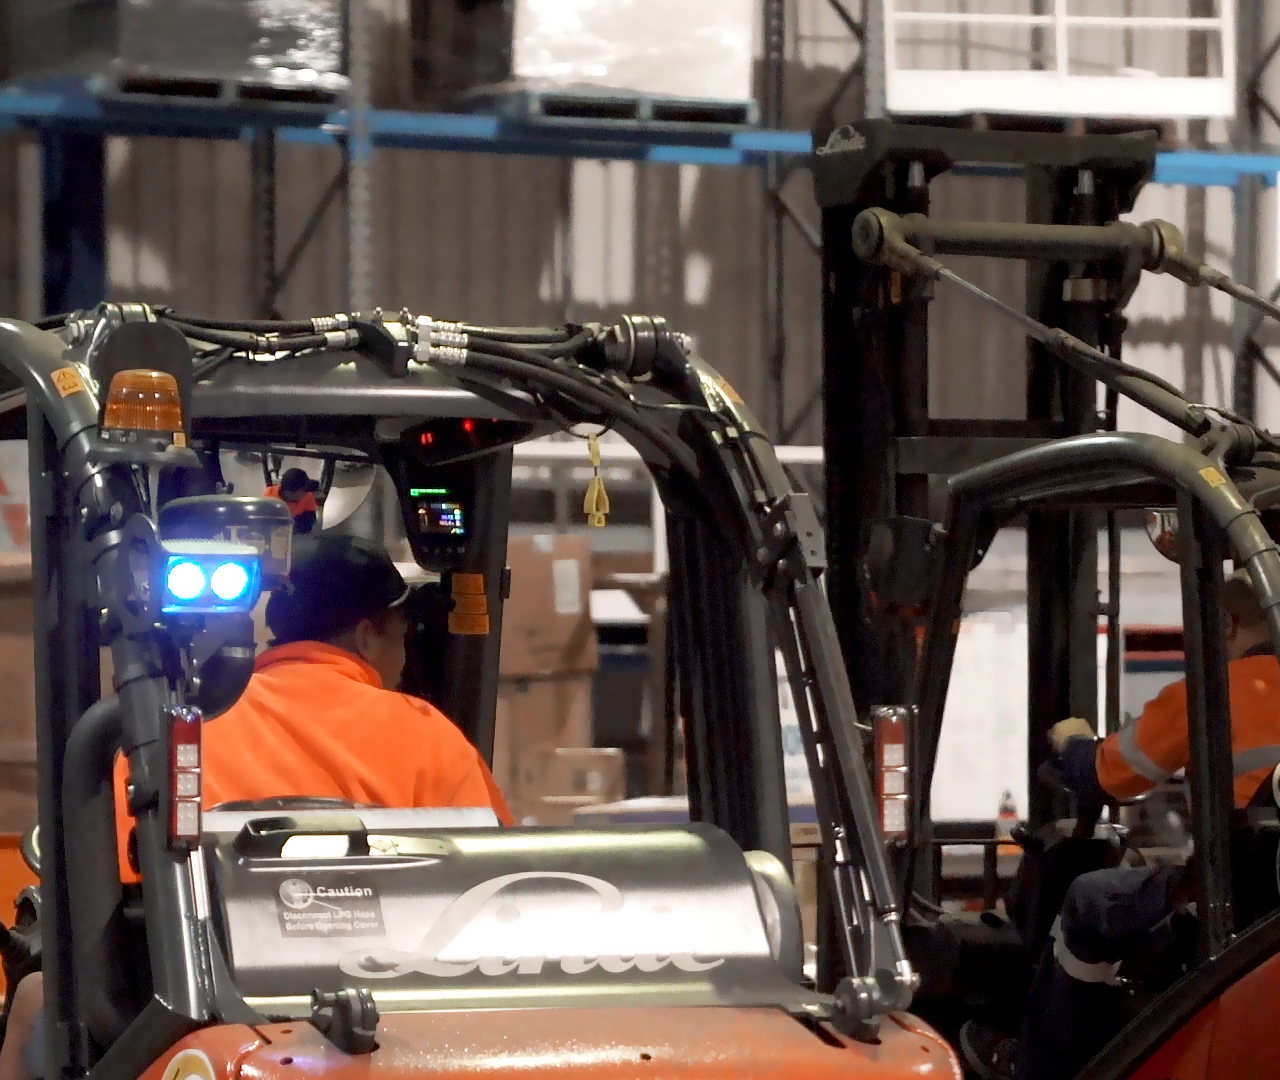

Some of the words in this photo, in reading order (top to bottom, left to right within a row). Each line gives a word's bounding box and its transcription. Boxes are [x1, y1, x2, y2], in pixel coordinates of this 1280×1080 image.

[316, 885, 373, 898] Caution
[333, 910, 352, 919] LPG
[285, 921, 314, 930] Before
